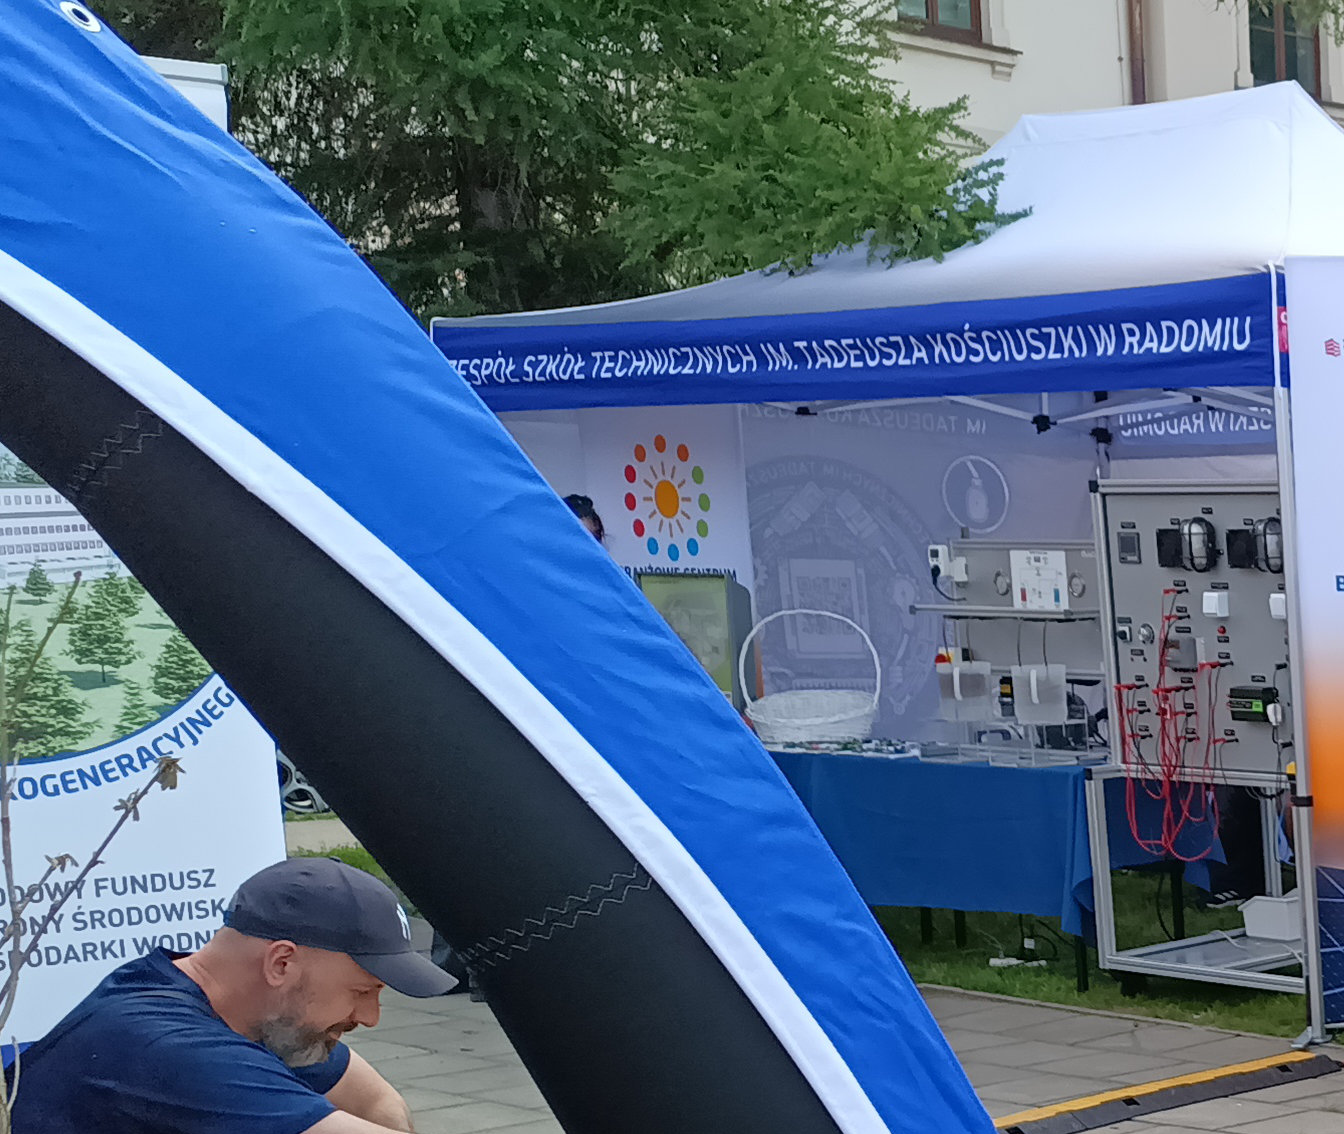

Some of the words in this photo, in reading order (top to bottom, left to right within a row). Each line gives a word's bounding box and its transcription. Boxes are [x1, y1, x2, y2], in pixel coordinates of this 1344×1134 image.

[523, 347, 585, 382] SZKÓŁ
[591, 345, 757, 379] TECHNICZNYCH
[761, 342, 799, 371] IM.
[800, 337, 929, 371] TADEUSZA
[931, 323, 1086, 364] KOŚCIUSZKI
[1088, 324, 1116, 357] W
[1122, 316, 1251, 355] RADOMIU
[94, 868, 216, 898] FUNDUSZ
